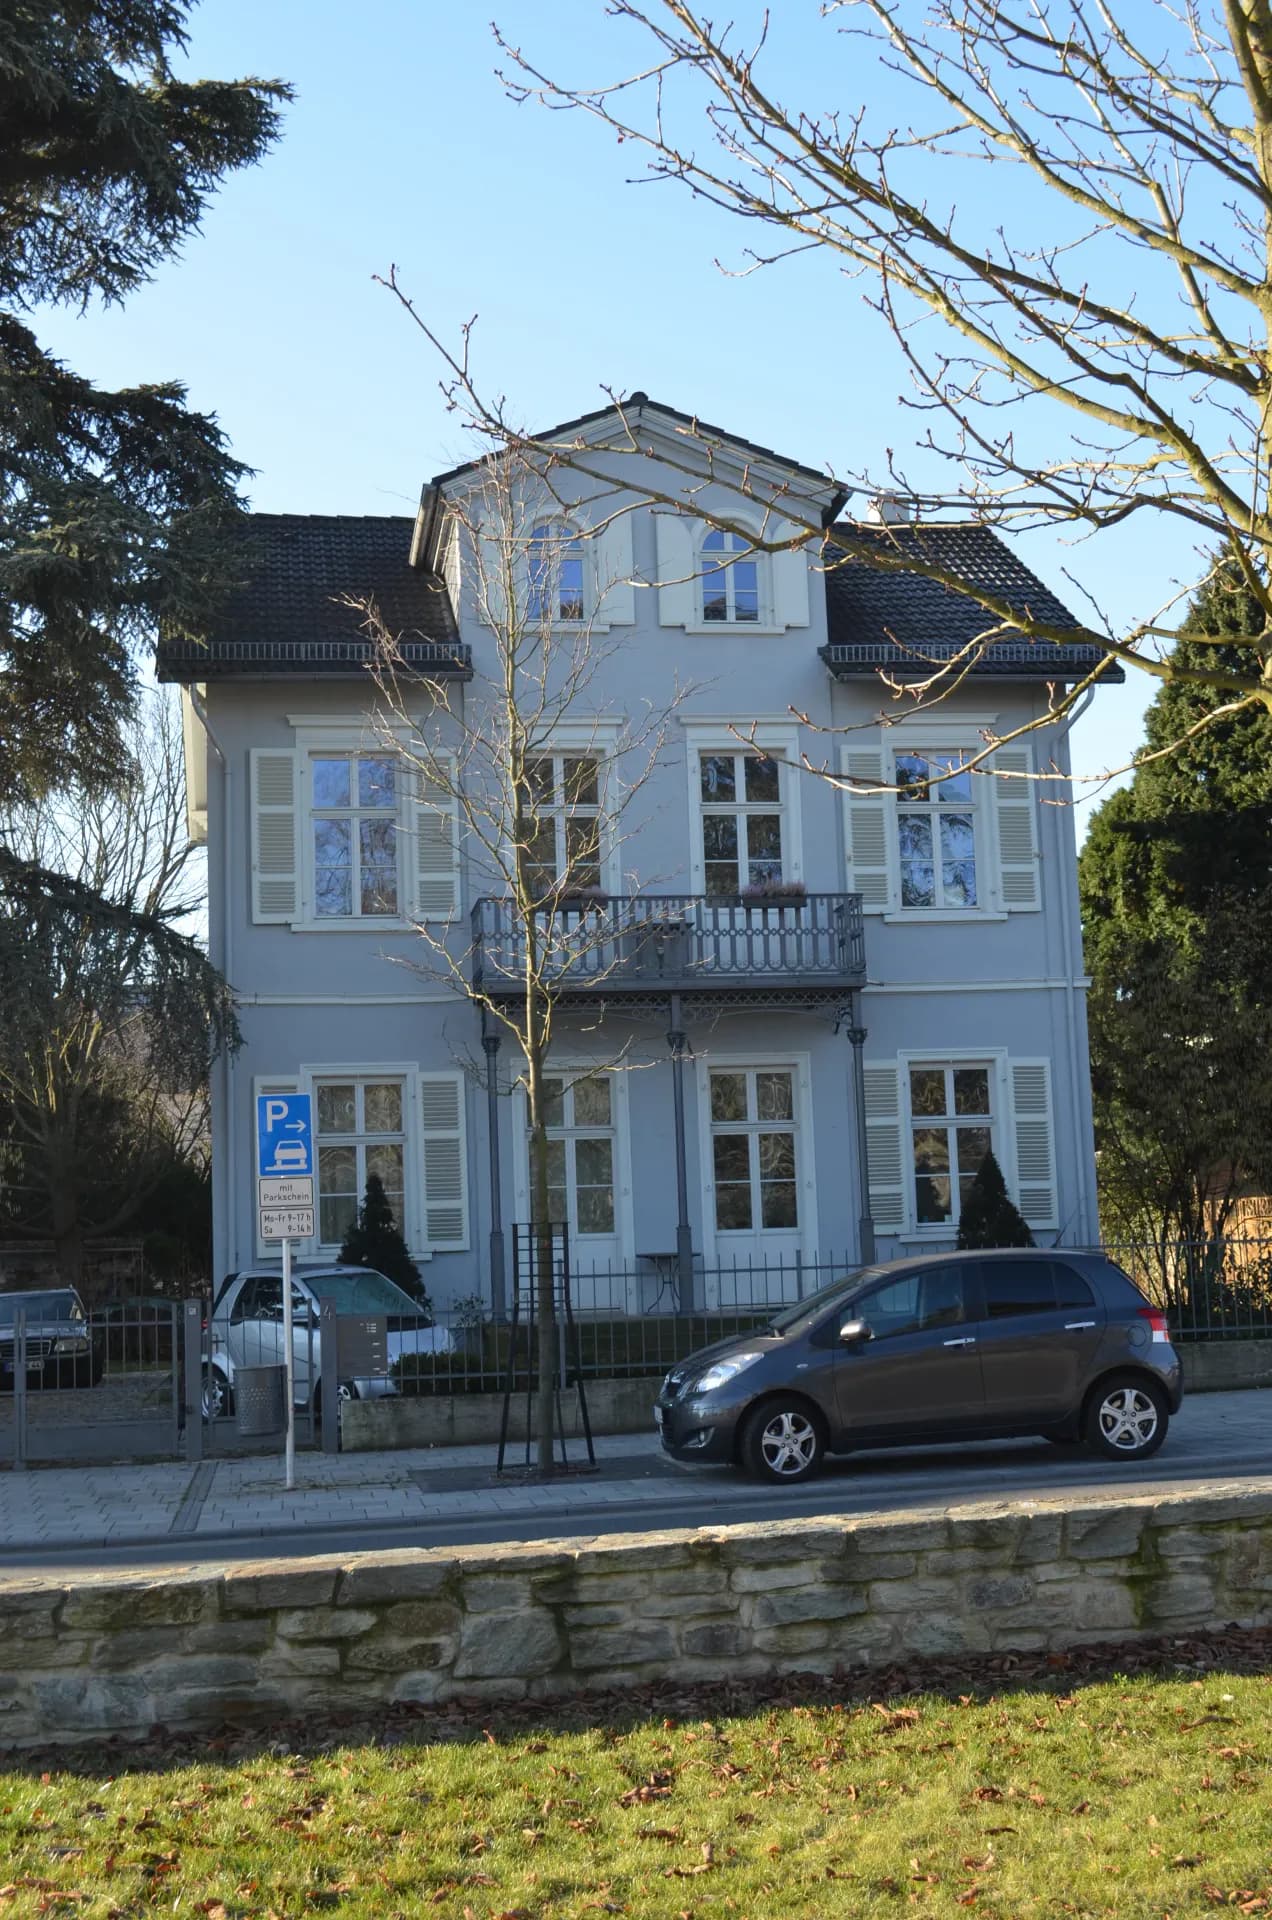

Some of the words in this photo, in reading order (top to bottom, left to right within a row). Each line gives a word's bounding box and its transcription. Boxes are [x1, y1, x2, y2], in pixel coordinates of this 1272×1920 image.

[266, 1100, 289, 1132] P
[279, 1184, 293, 1192] mit
[263, 1192, 310, 1201] Parkschein
[264, 1214, 286, 1223] Mo-Fr
[288, 1213, 304, 1221] 9-17
[306, 1213, 311, 1221] h
[264, 1225, 273, 1234] Sa
[288, 1224, 305, 1232] 9-14
[306, 1223, 312, 1232] h
[323, 1305, 331, 1320] 4
